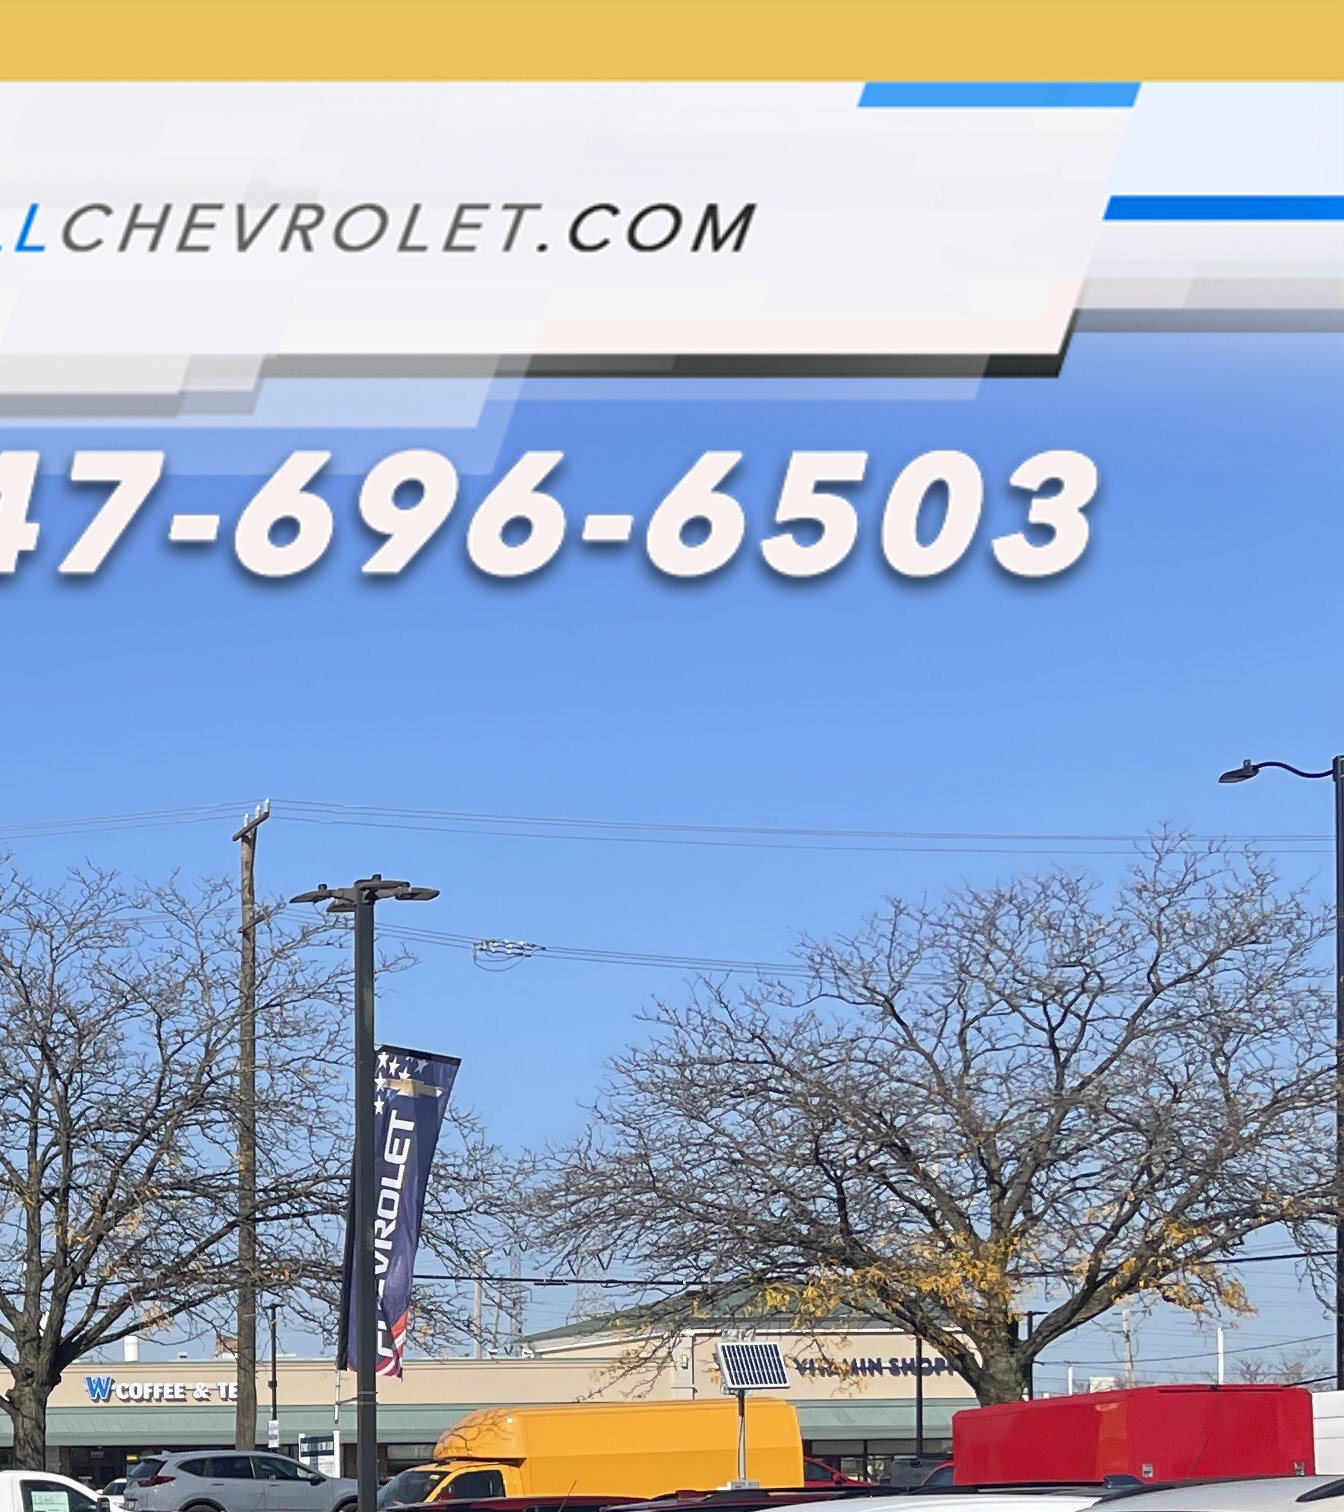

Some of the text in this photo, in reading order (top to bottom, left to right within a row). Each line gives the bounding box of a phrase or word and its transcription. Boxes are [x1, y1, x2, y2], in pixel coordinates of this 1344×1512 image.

[115, 1383, 188, 1400] COFFEE
[192, 1383, 209, 1399] &
[217, 1383, 238, 1399] TE
